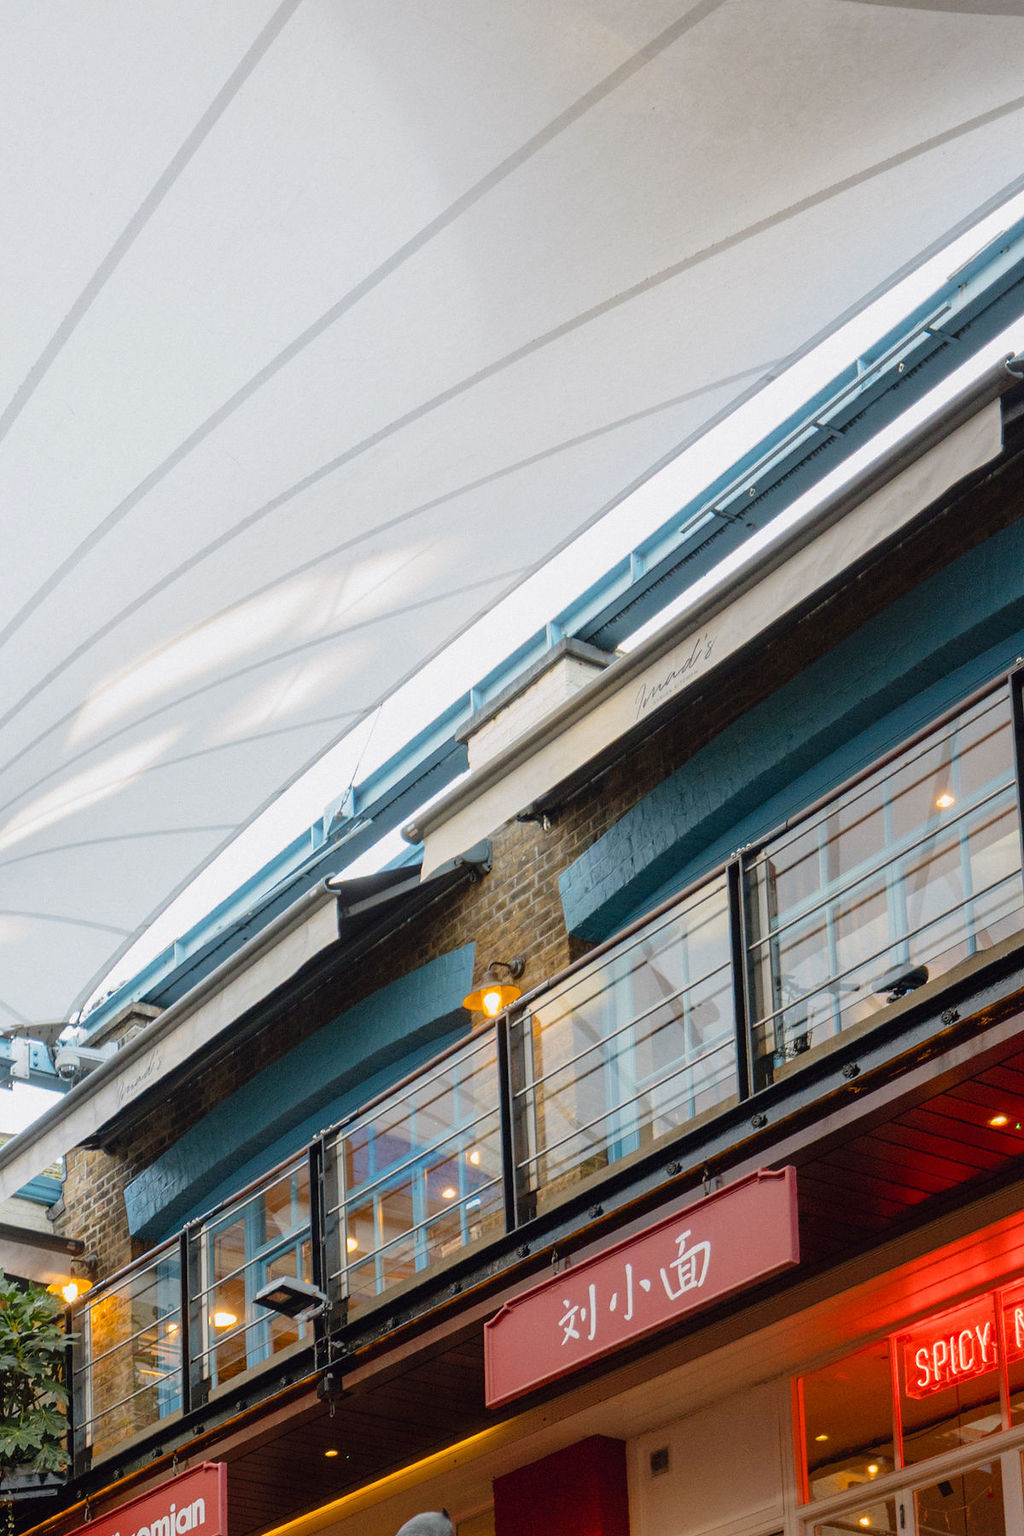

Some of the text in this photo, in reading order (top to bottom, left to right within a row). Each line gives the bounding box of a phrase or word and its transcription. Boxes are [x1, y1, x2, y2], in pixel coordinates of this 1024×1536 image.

[635, 632, 717, 720] Imad's
[558, 1229, 711, 1346] 刘小面
[916, 1321, 990, 1386] SPICY
